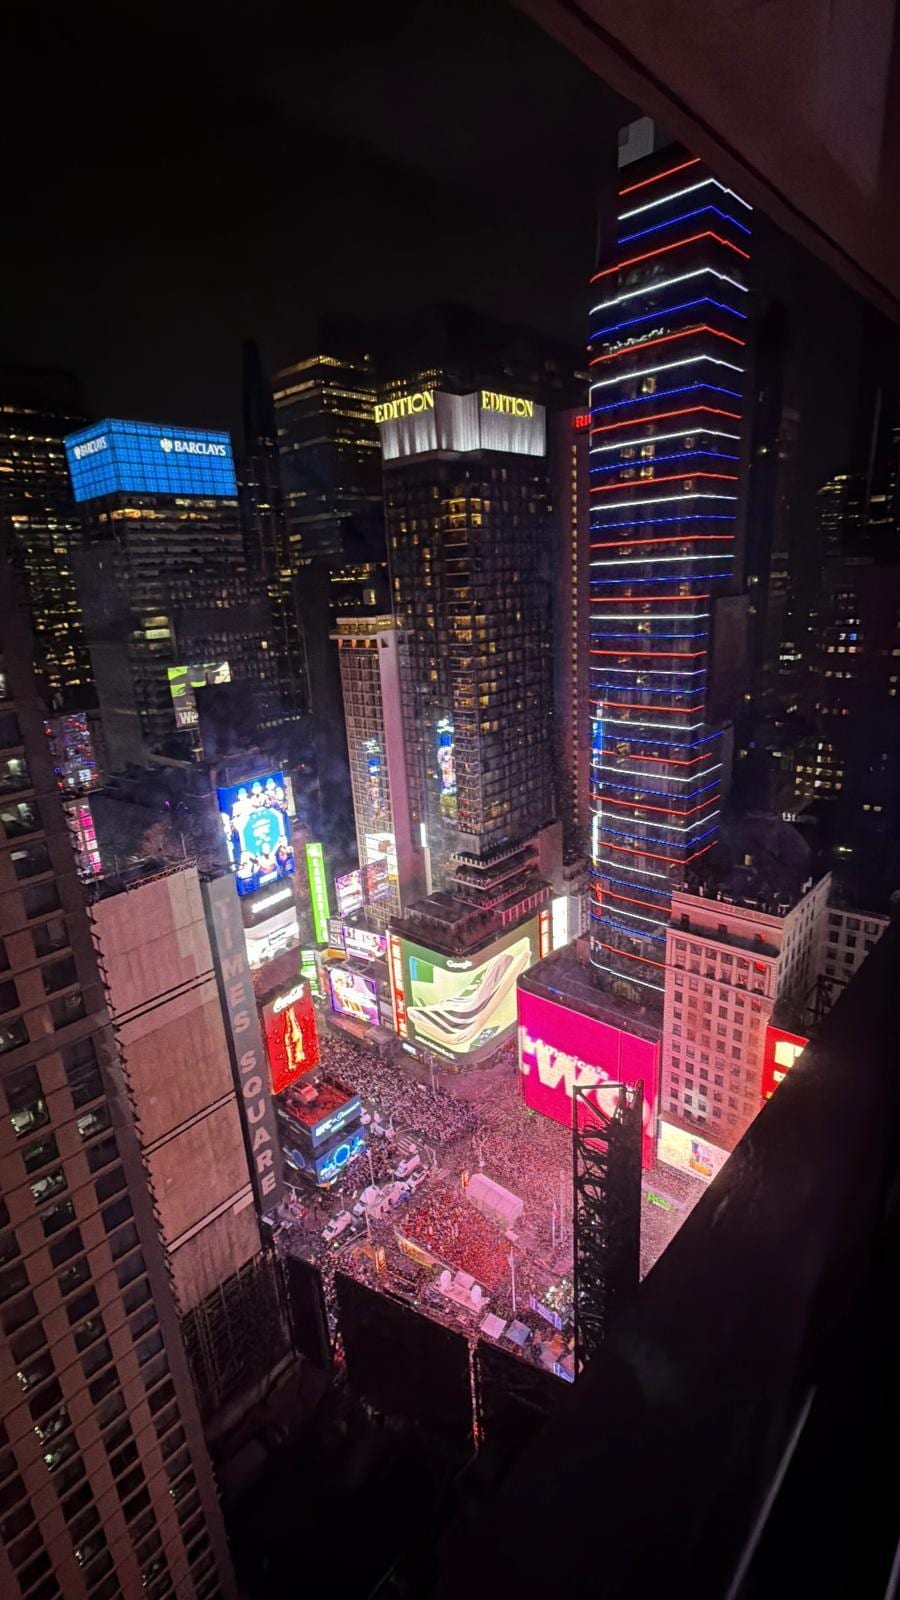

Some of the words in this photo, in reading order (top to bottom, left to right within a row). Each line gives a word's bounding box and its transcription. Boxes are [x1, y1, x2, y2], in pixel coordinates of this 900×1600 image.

[373, 389, 435, 424] EDITION
[480, 389, 533, 418] EDITION
[174, 440, 226, 456] BARCLAYS
[446, 959, 473, 969] Google
[214, 899, 251, 1034] TIMES
[240, 1050, 277, 1196] SQUARE
